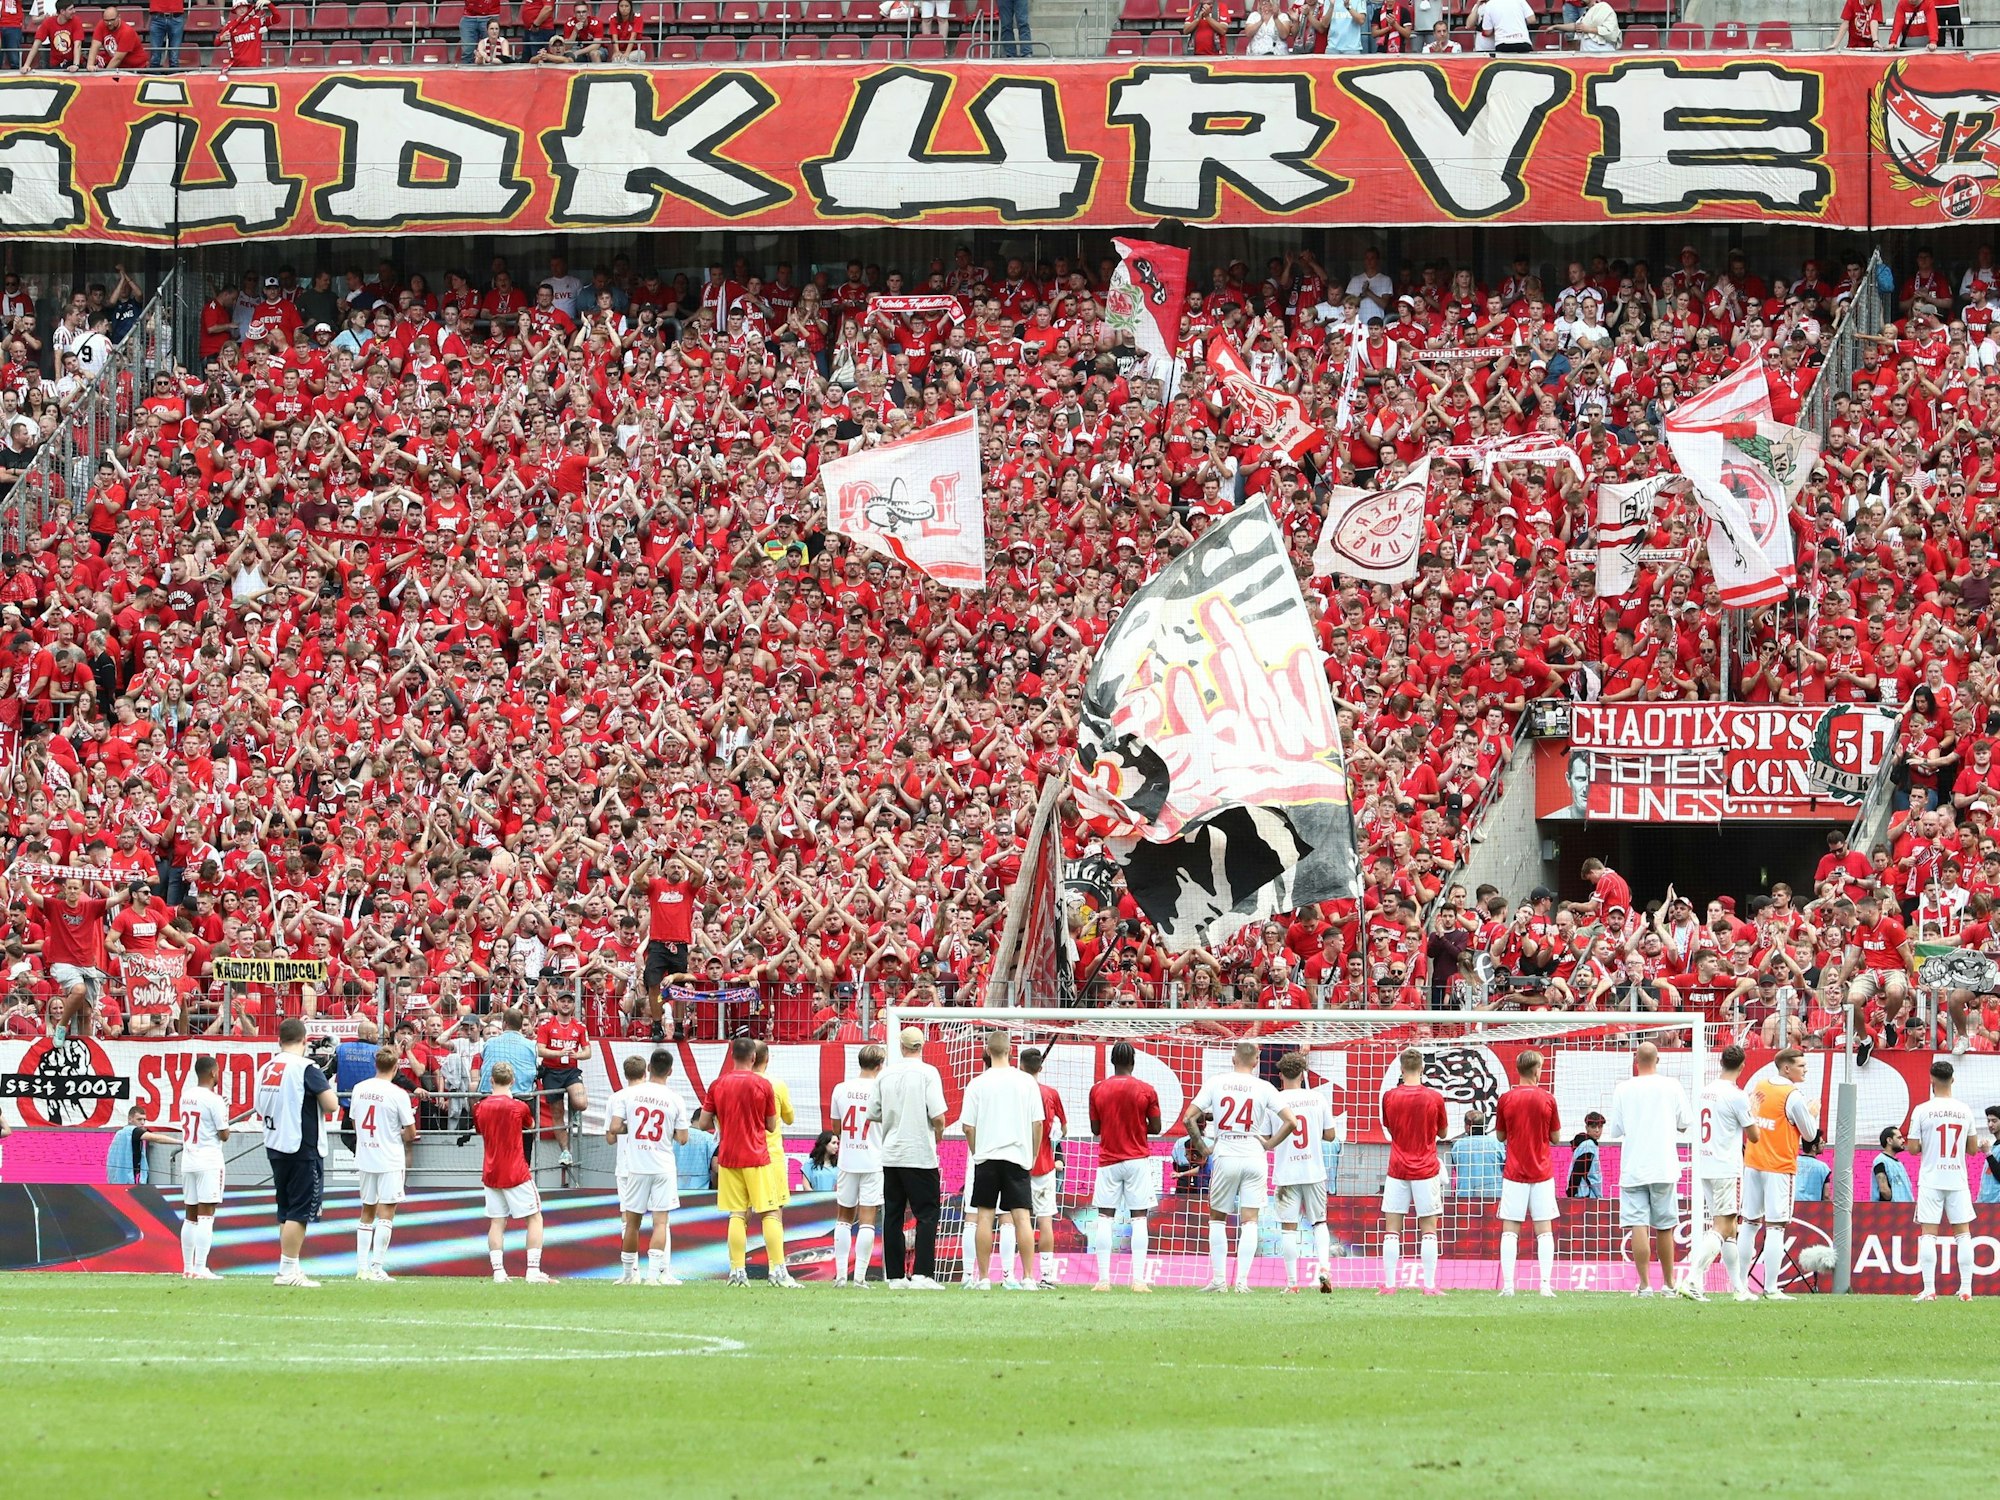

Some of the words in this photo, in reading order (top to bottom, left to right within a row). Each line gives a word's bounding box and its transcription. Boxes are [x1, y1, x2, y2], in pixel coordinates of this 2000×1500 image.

[234, 32, 255, 44] REWE
[1936, 111, 1995, 164] 12
[1952, 201, 1970, 213] KÖLN
[554, 292, 572, 300] EWE
[703, 299, 718, 308] REW
[771, 298, 793, 307] REWE
[115, 309, 134, 320] RWE
[1967, 323, 1987, 332] REWE
[82, 345, 92, 363] 9
[489, 348, 507, 356] RWE
[904, 348, 925, 357] REWE
[1419, 348, 1504, 359] DOUBLESIEGER
[1913, 356, 1936, 366] REWE
[653, 535, 671, 544] REW
[1571, 706, 1730, 748] CHAOTIX
[1730, 711, 1814, 751] SPS
[1588, 752, 1722, 785] HÖHER
[1730, 759, 1815, 796] CGN
[1588, 786, 1722, 821] JUNGS
[40, 864, 125, 882] SYNDIKAT
[478, 940, 494, 950] REW
[1863, 940, 1886, 951] REWE
[1553, 953, 1576, 962] RWE
[1689, 993, 1714, 1002] REWE
[331, 1024, 358, 1034] KÖLN
[550, 1039, 579, 1049] REWE
[65, 1078, 123, 1096] 2007
[1221, 1083, 1253, 1093] CHABOT
[359, 1093, 384, 1104] HÜBERS
[633, 1095, 670, 1108] ADAMYAN
[1700, 1097, 1717, 1108] ARTEL
[1217, 1096, 1254, 1132] 24
[361, 1104, 376, 1138] 4
[634, 1106, 665, 1142] 23
[842, 1105, 871, 1141] 47
[1755, 1119, 1776, 1131] EWE
[181, 1111, 201, 1144] 37
[1293, 1115, 1309, 1149] 9
[1700, 1113, 1711, 1148] 6
[1936, 1123, 1963, 1158] 17
[1947, 1163, 1961, 1171] KÖLN
[1853, 1234, 2000, 1275] AUTO
